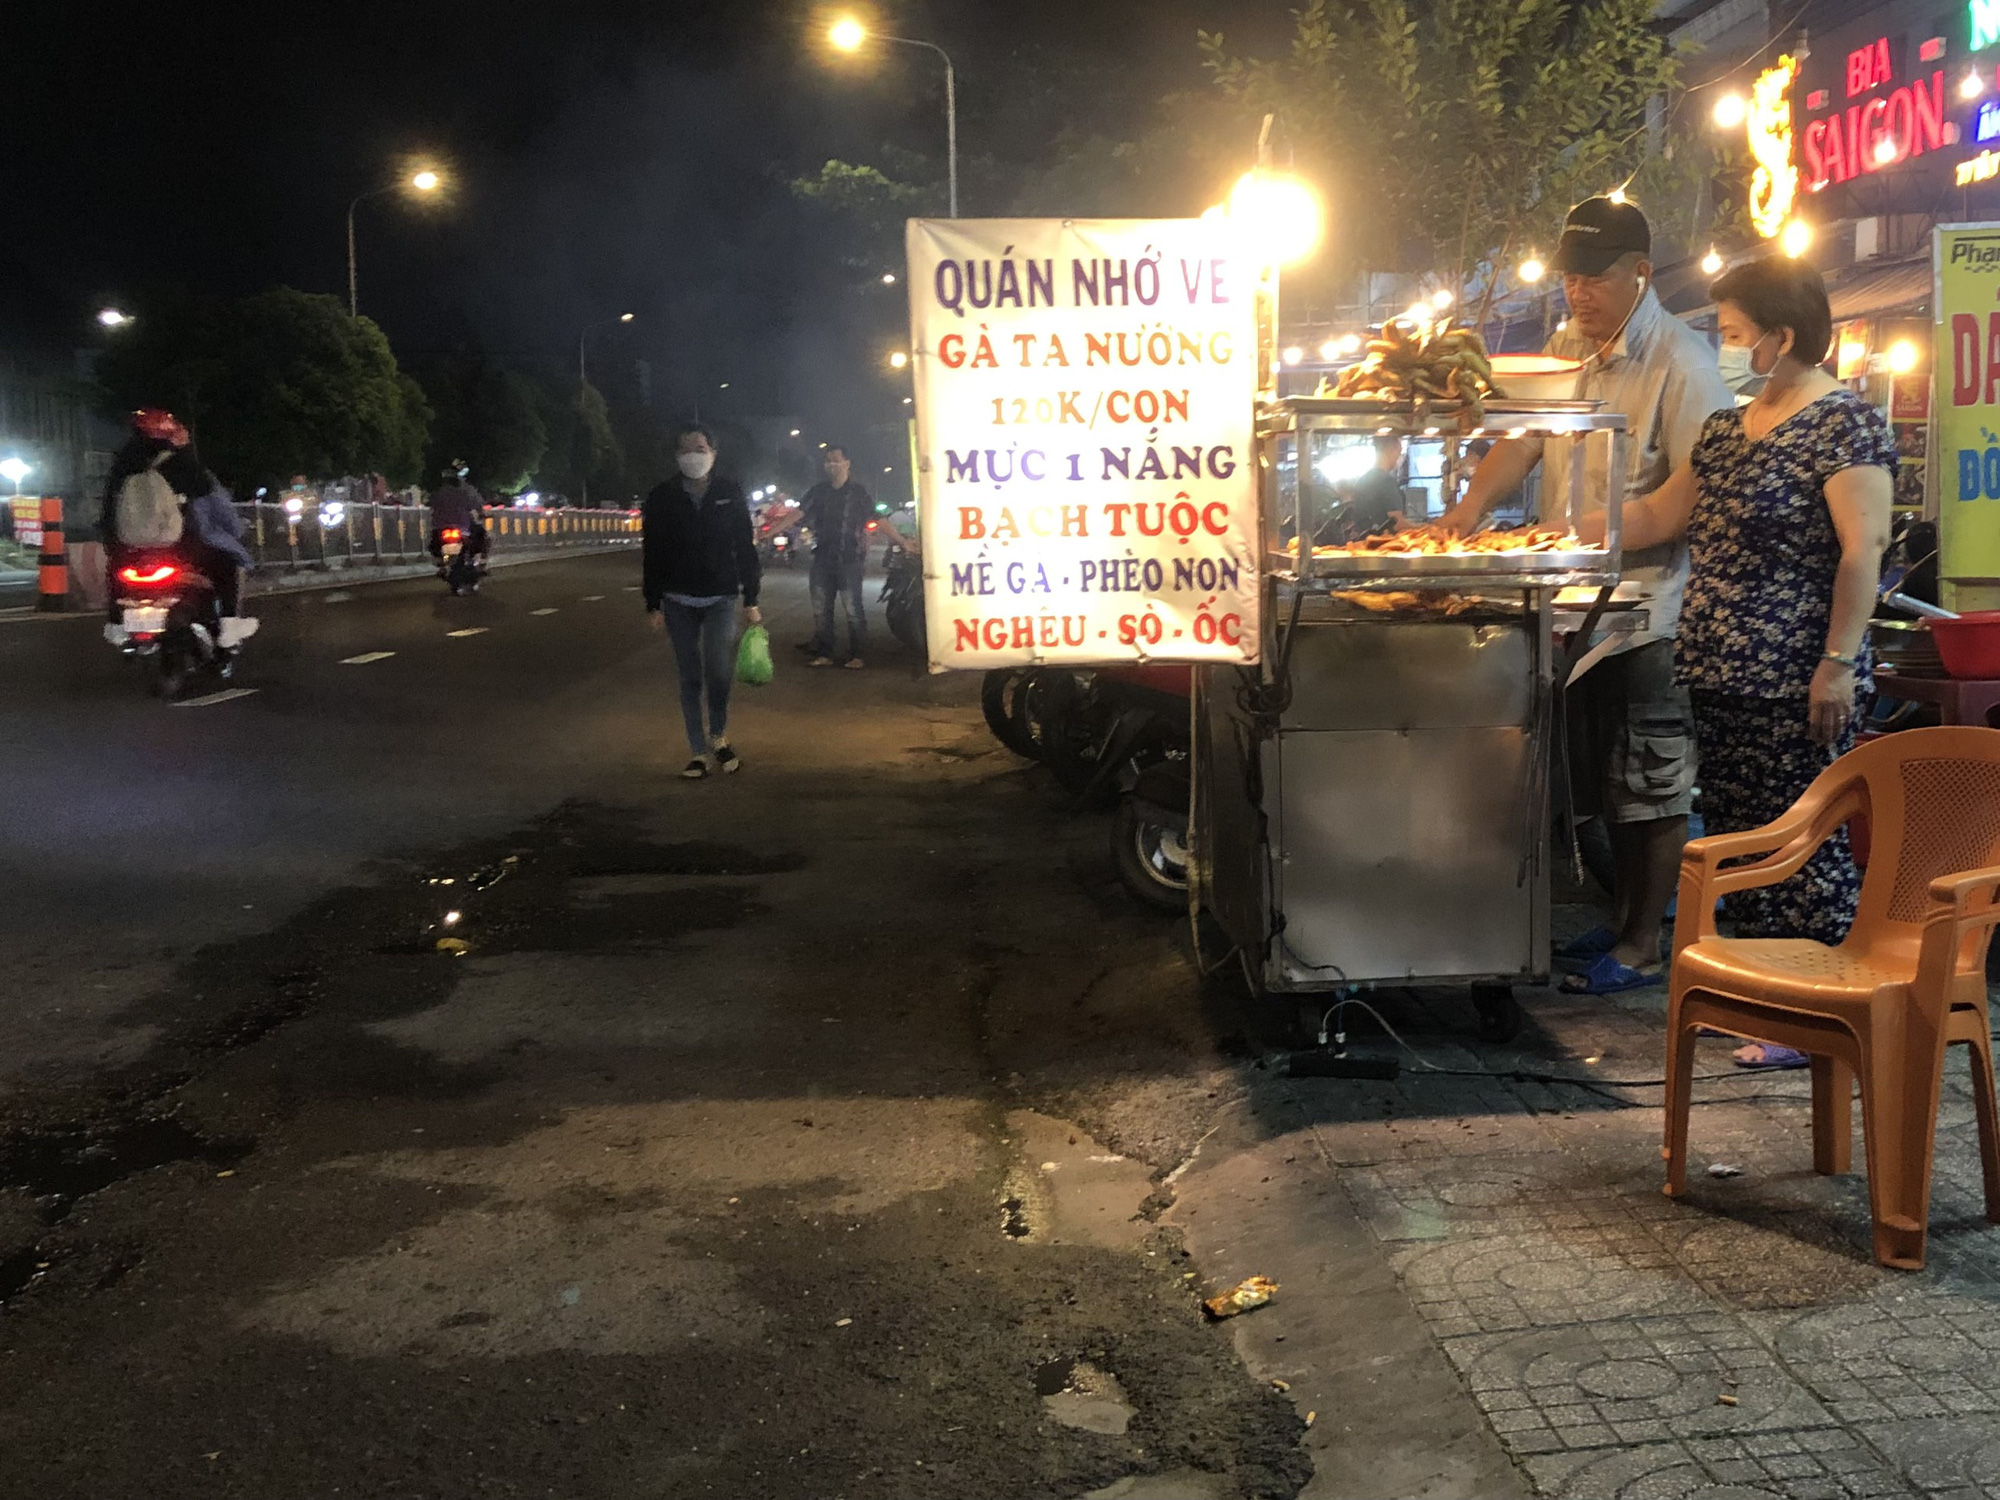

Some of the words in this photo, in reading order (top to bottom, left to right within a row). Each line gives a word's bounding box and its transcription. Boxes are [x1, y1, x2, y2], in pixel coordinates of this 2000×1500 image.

[1846, 37, 1892, 97] BIA
[1802, 70, 1944, 192] SAIGON
[934, 245, 1055, 318] QUÁN
[1072, 244, 1162, 308] NHỚ
[938, 323, 999, 369] GÀ
[1012, 333, 1070, 368] TA
[1084, 322, 1234, 367] NƯỚNG
[991, 388, 1190, 431] 120K/CON
[945, 441, 1047, 491] MỰC
[1065, 453, 1085, 481] 1
[1100, 427, 1237, 481] NẮNG
[957, 504, 1090, 547] BẠCH
[1103, 491, 1229, 545] TUỘC
[950, 542, 996, 597] MỀ
[1079, 548, 1164, 593] PHÈO
[1171, 557, 1240, 592] NON
[953, 605, 1087, 652] NGHÊU
[1117, 602, 1163, 646] SÒ
[1192, 594, 1242, 647] ỐC
